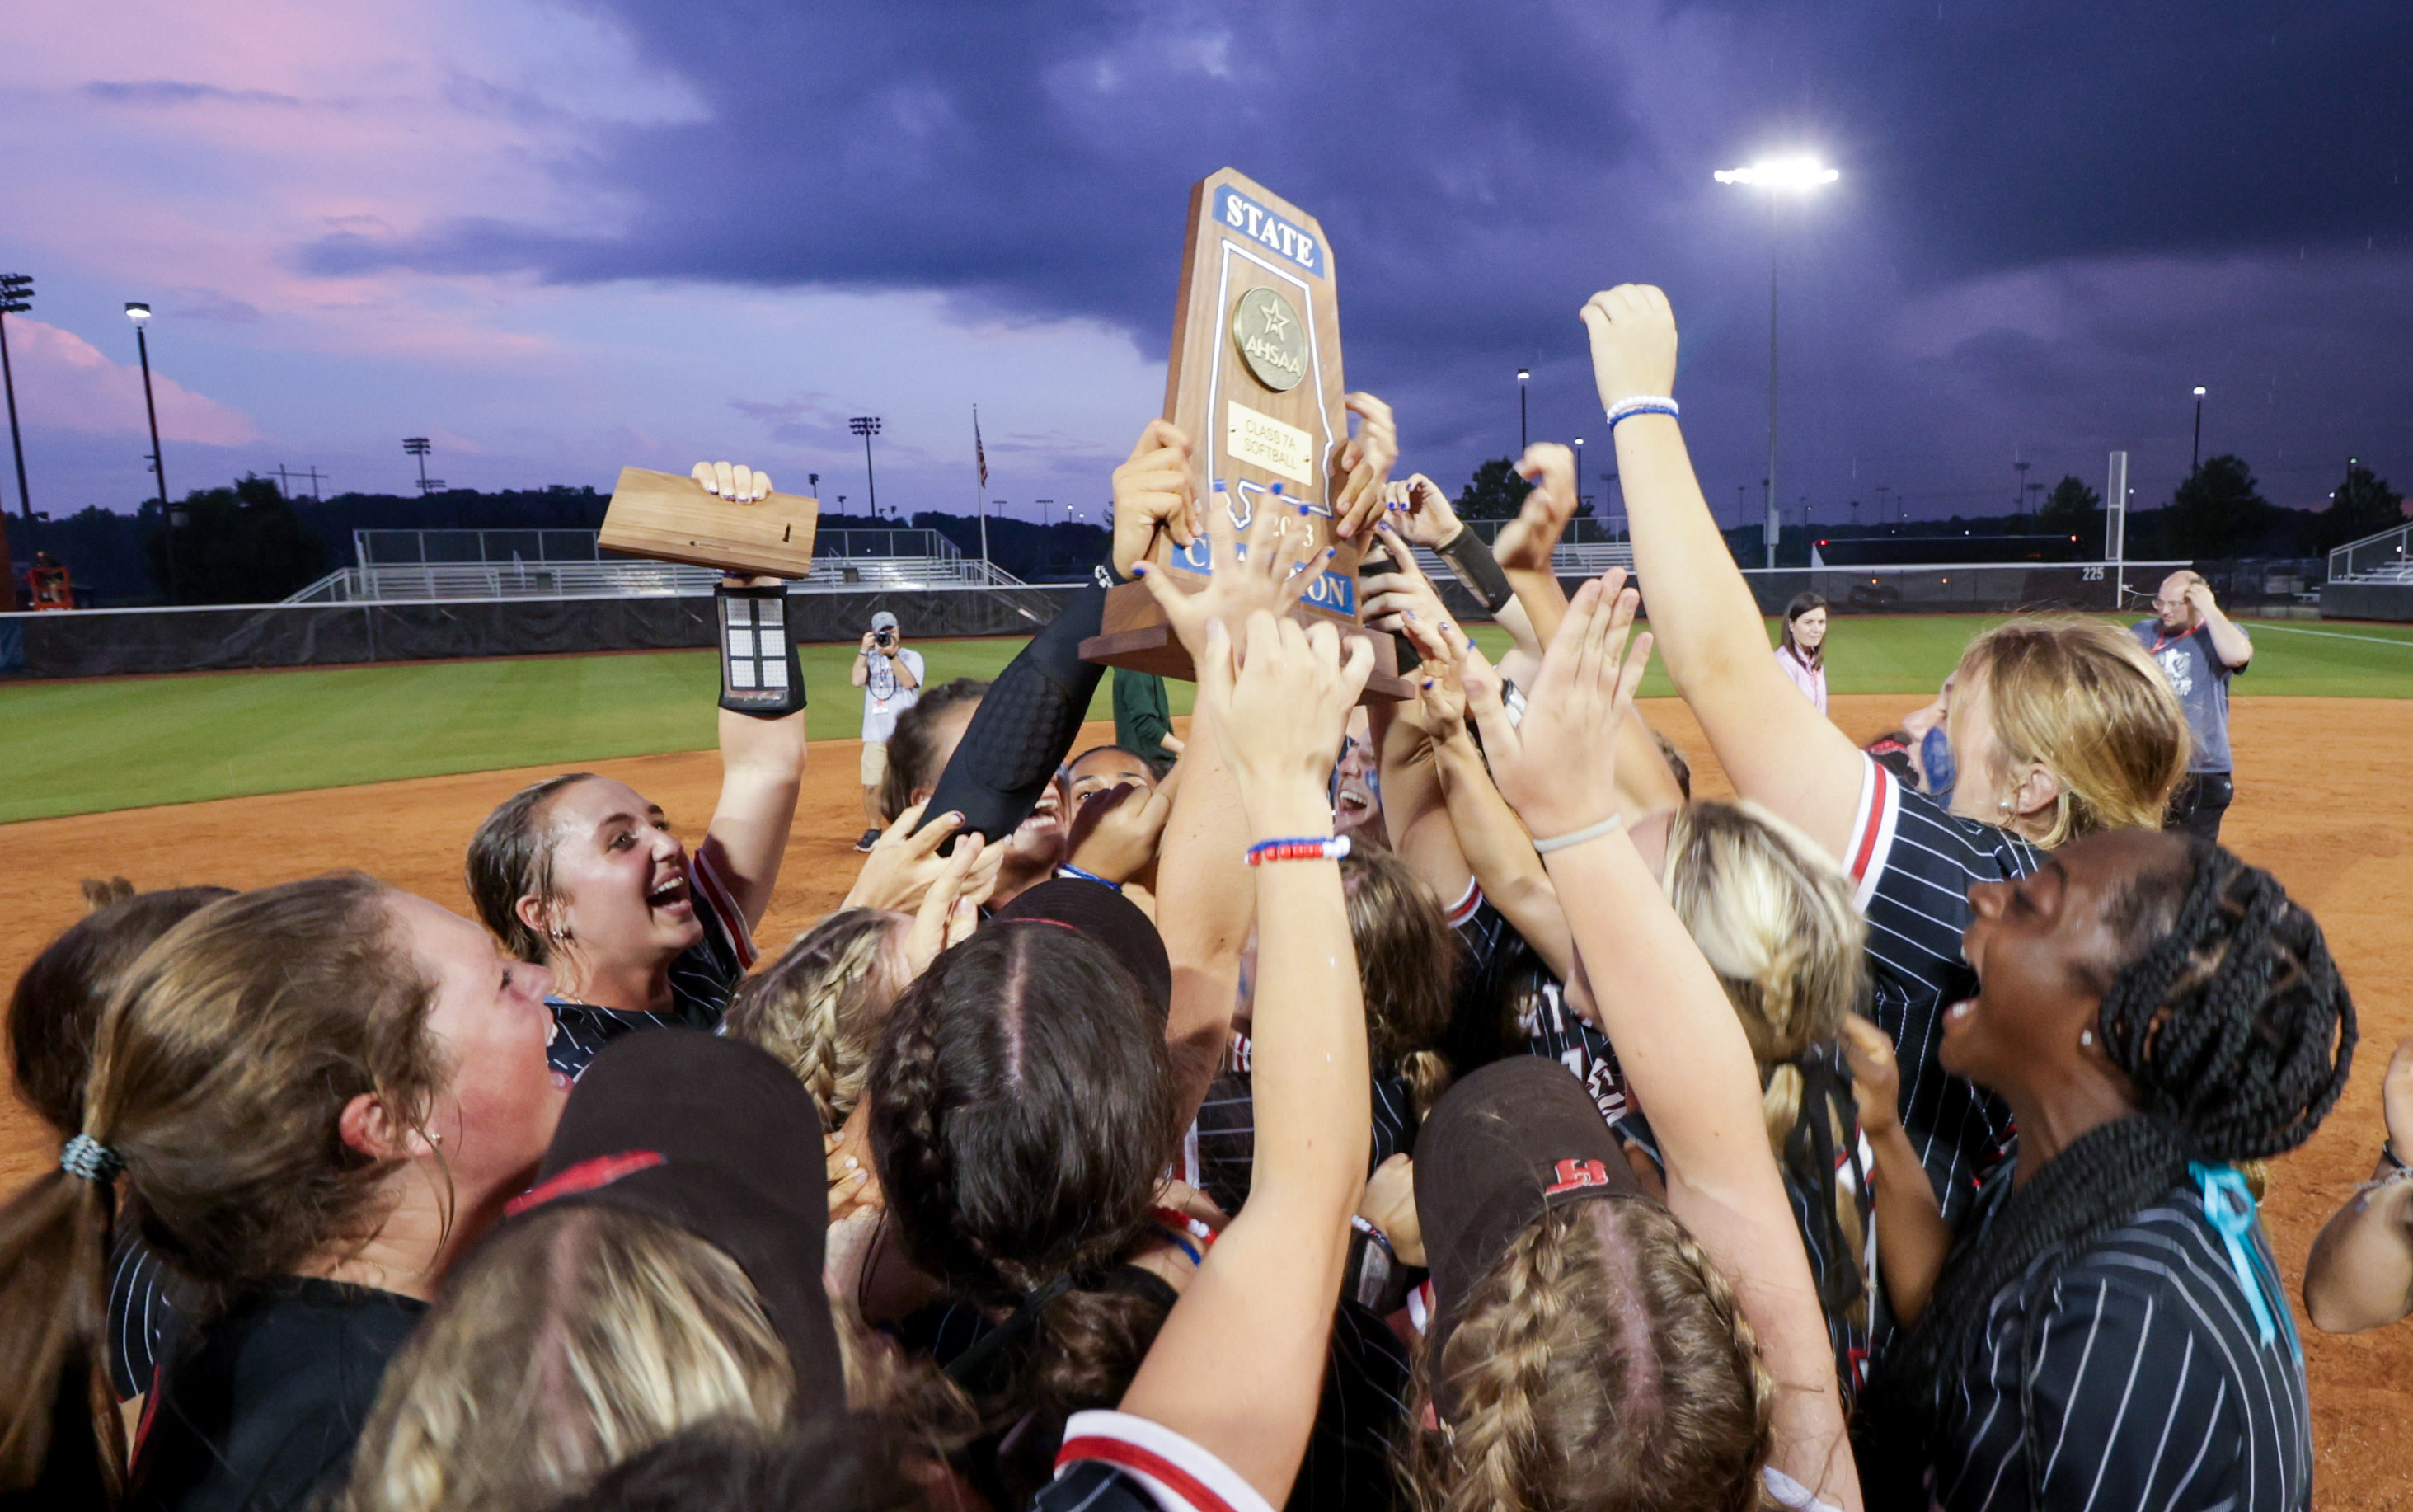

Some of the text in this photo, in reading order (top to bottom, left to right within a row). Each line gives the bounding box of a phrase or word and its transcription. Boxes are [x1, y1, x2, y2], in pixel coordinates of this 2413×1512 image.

[1227, 195, 1313, 268] STATE
[1246, 335, 1300, 373] AHSAA
[1246, 420, 1296, 451] CLASS 7A
[1245, 438, 1297, 470] SOFTBALL
[2082, 566, 2105, 581] 225
